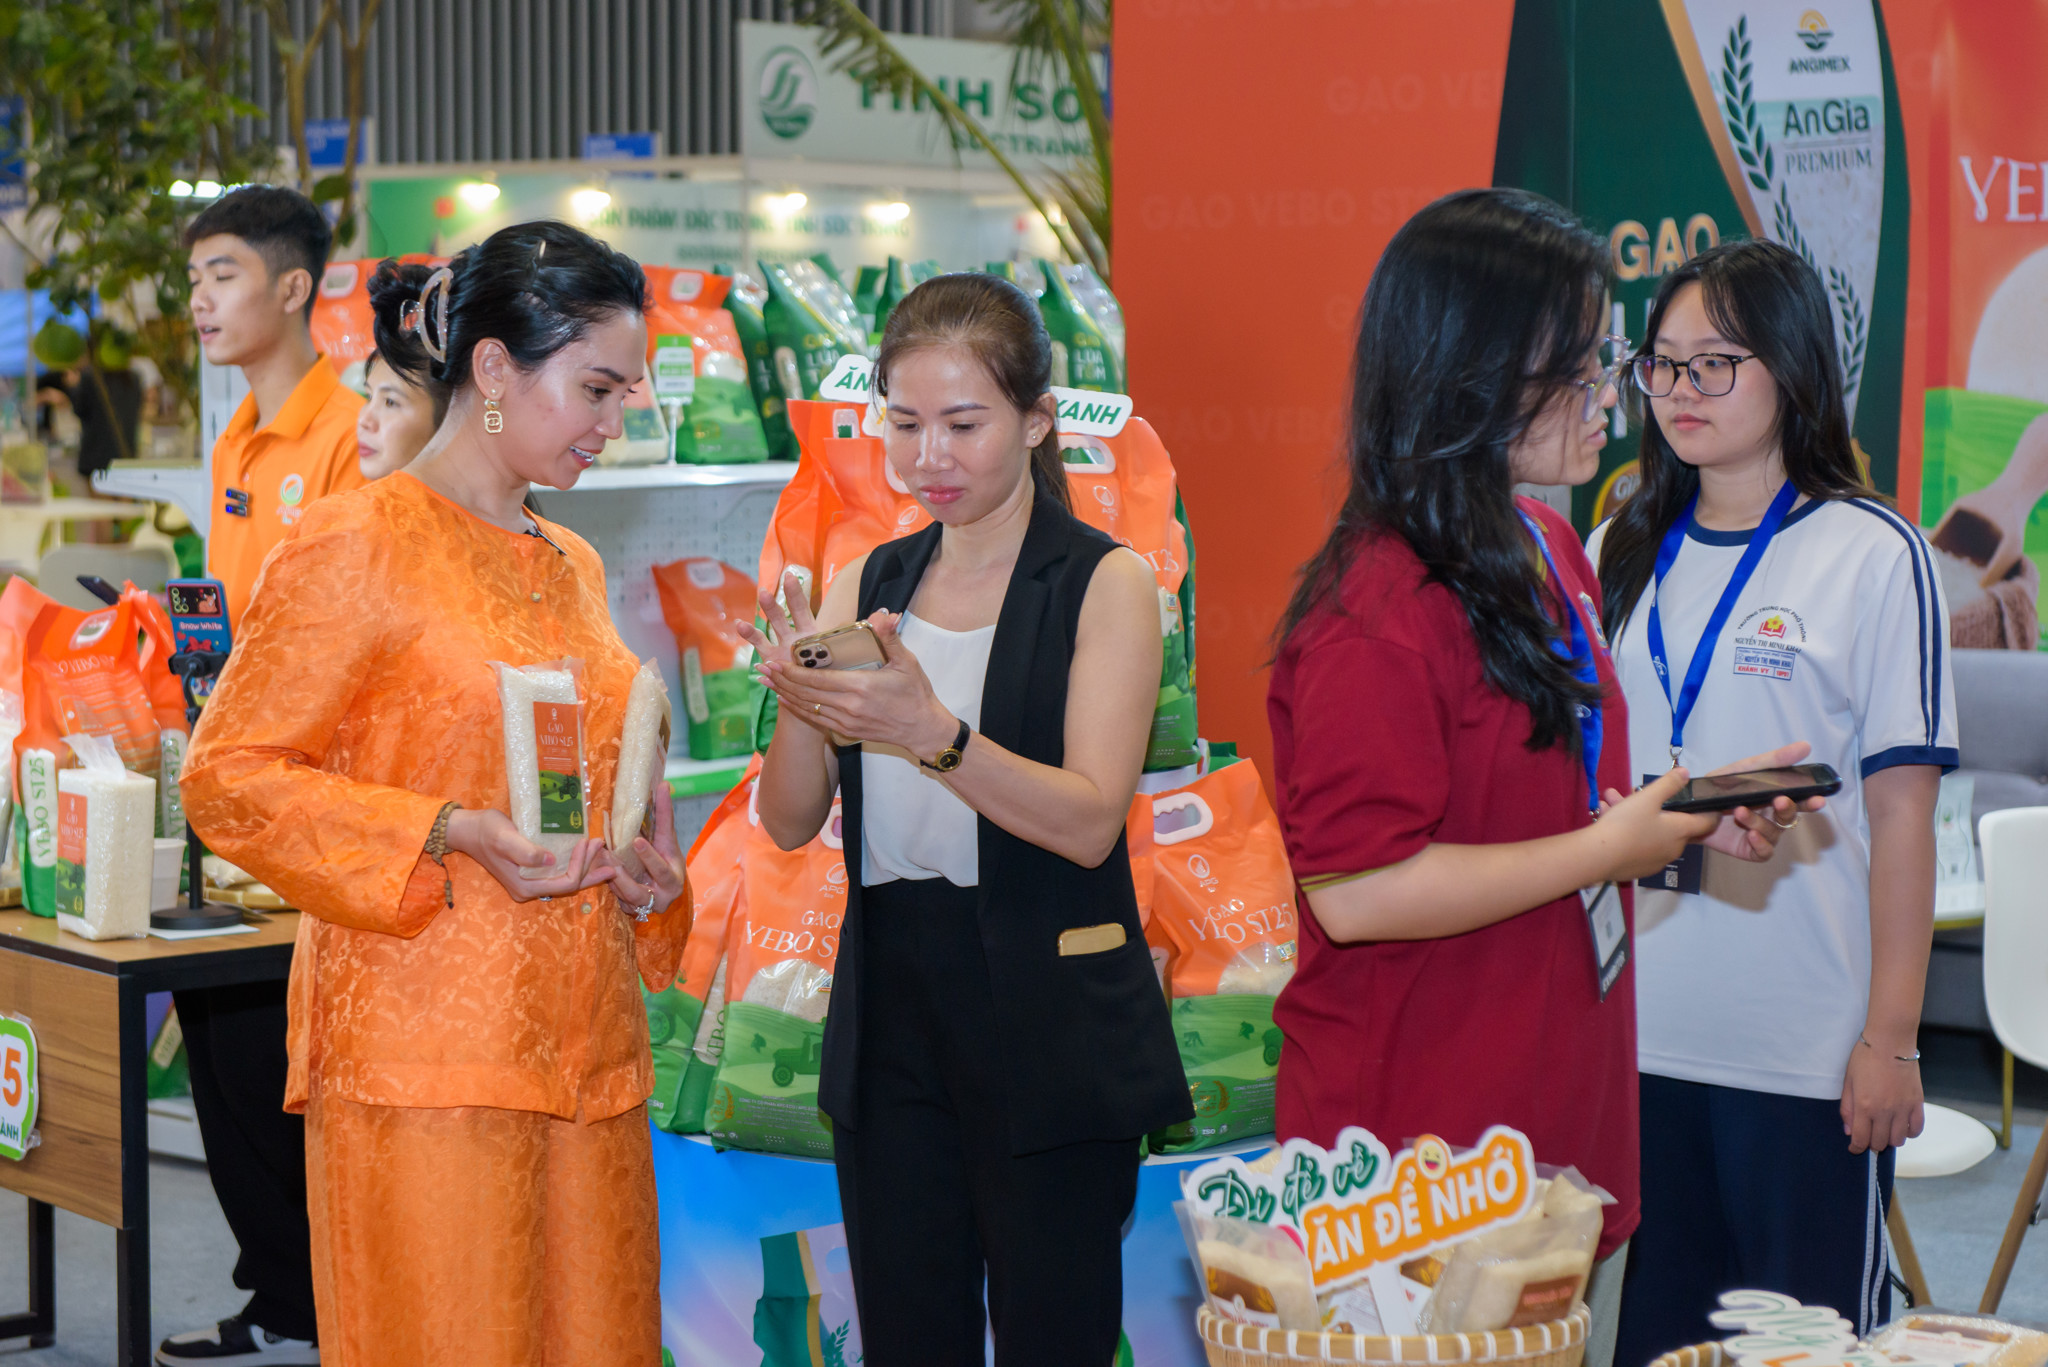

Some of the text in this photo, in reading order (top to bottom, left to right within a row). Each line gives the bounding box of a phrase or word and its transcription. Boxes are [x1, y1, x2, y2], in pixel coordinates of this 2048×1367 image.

[1789, 56, 1851, 75] ANGIMEX
[1784, 98, 1871, 137] AnGia
[1786, 148, 1872, 175] PREMIUM
[201, 621, 223, 631] White
[1246, 902, 1294, 935] ST25
[1314, 1212, 1365, 1272] ĂN
[1430, 1144, 1519, 1227] NHỚ
